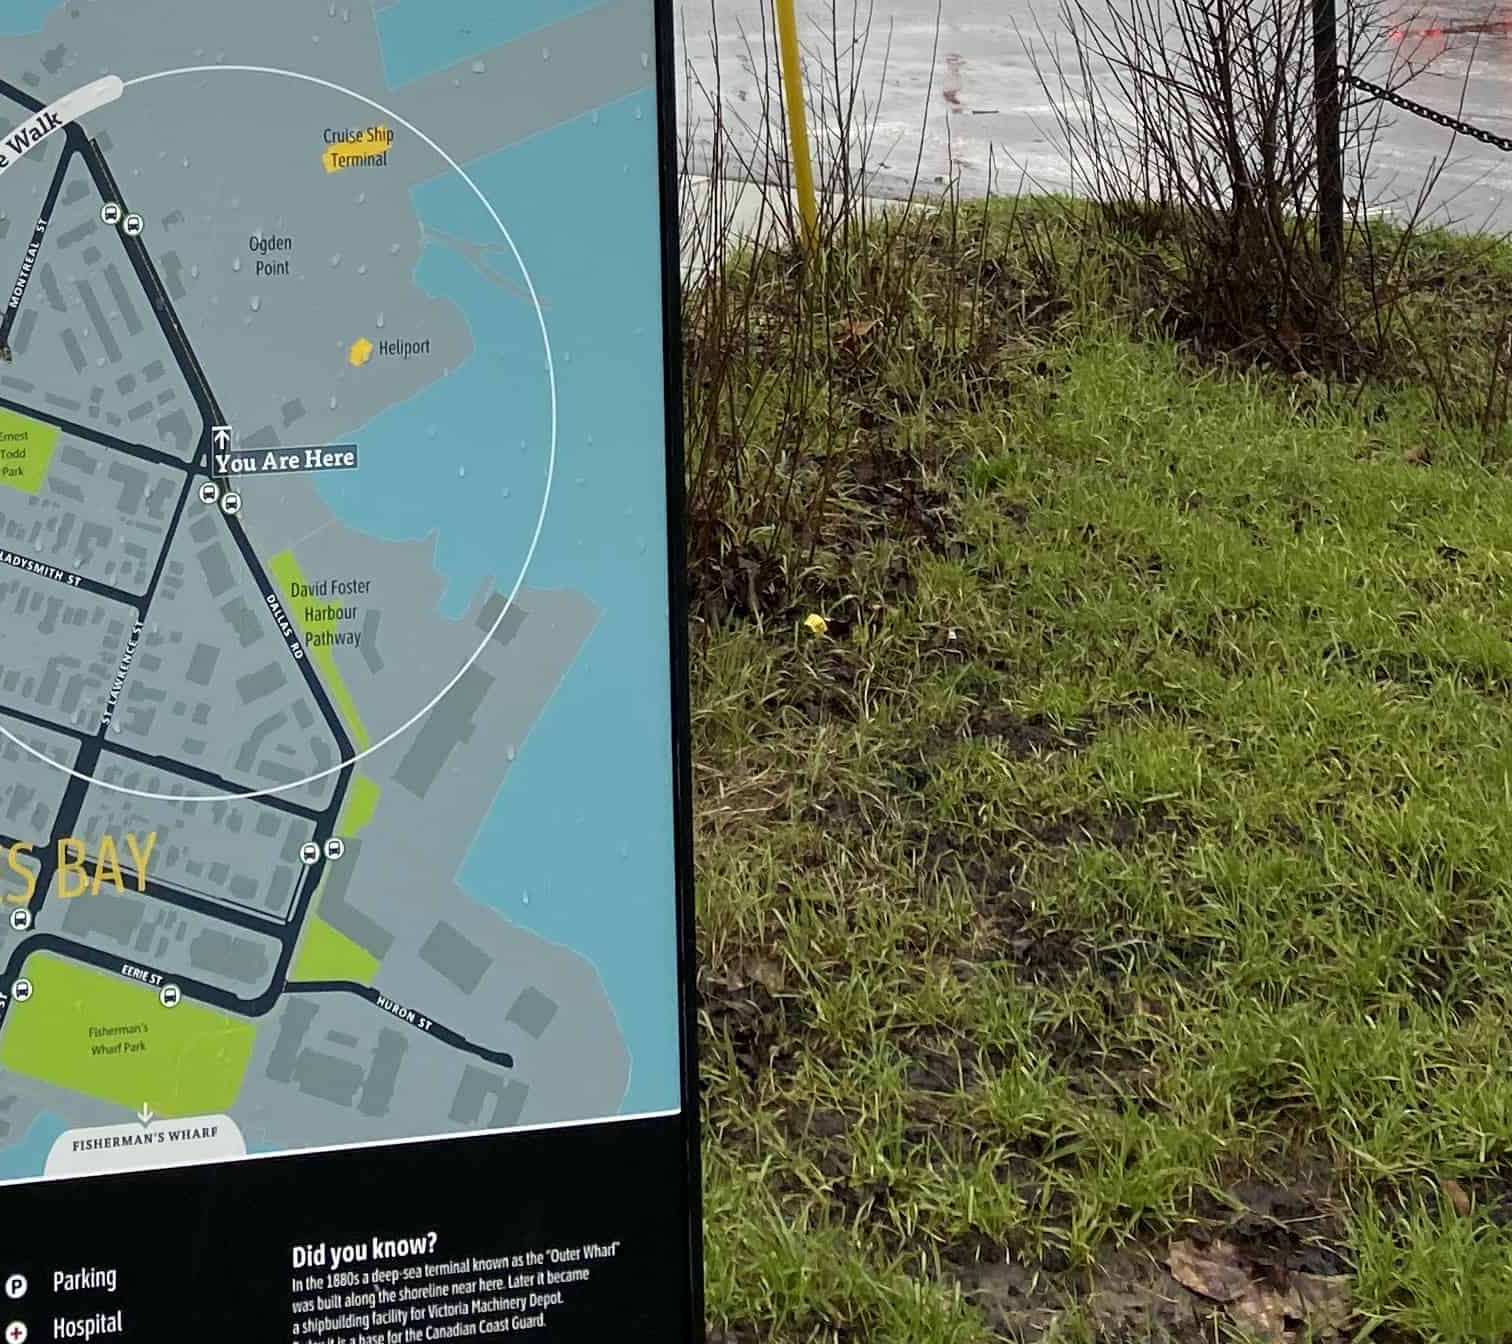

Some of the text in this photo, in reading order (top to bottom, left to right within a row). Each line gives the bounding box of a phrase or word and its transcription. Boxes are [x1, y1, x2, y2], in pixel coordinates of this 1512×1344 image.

[6, 112, 62, 154] Walk
[323, 127, 394, 147] Cruise Ship
[331, 152, 387, 168] Terminal
[249, 236, 292, 254] Ogden
[10, 219, 49, 307] MONTREAL ST
[256, 260, 289, 276] Point
[379, 339, 430, 357] Heliport
[0, 448, 26, 460] Todd
[215, 449, 355, 474] You Are Here
[2, 465, 24, 477] Park
[0, 552, 82, 587] LADYSMITH ST
[291, 579, 371, 597] David Foster
[266, 594, 304, 660] DALLAS RD
[305, 605, 357, 623] Harbour
[305, 631, 361, 649] Pathway
[102, 622, 144, 723] ST LAWRENCE ST
[55, 832, 158, 899] BAY
[121, 964, 163, 985] EERIE ST
[376, 995, 433, 1031] HURON ST
[91, 1040, 146, 1056] Wharf Park
[72, 1126, 219, 1153] FISHERMAN'S WHARF
[292, 1232, 438, 1270] Did you know?
[53, 1267, 117, 1293] Parking
[292, 1278, 303, 1292] In
[306, 1275, 324, 1290] the
[327, 1273, 360, 1288] 1880s
[362, 1273, 369, 1284] a
[372, 1266, 422, 1285] deep-sea
[425, 1258, 470, 1277] terminal
[472, 1256, 509, 1272] known
[511, 1255, 524, 1268] as
[526, 1251, 544, 1266] the
[292, 1268, 589, 1313] was built along the shoreline near here. Later it became
[53, 1310, 123, 1341] Hospital
[293, 1291, 564, 1336] a shipbuilding facility for Victoria Machinery Depot.
[359, 1332, 385, 1344] base
[387, 1329, 402, 1344] for
[405, 1327, 423, 1342] the
[426, 1321, 476, 1340] Canadian
[479, 1317, 509, 1333] Coast
[512, 1312, 546, 1330] Guard.
